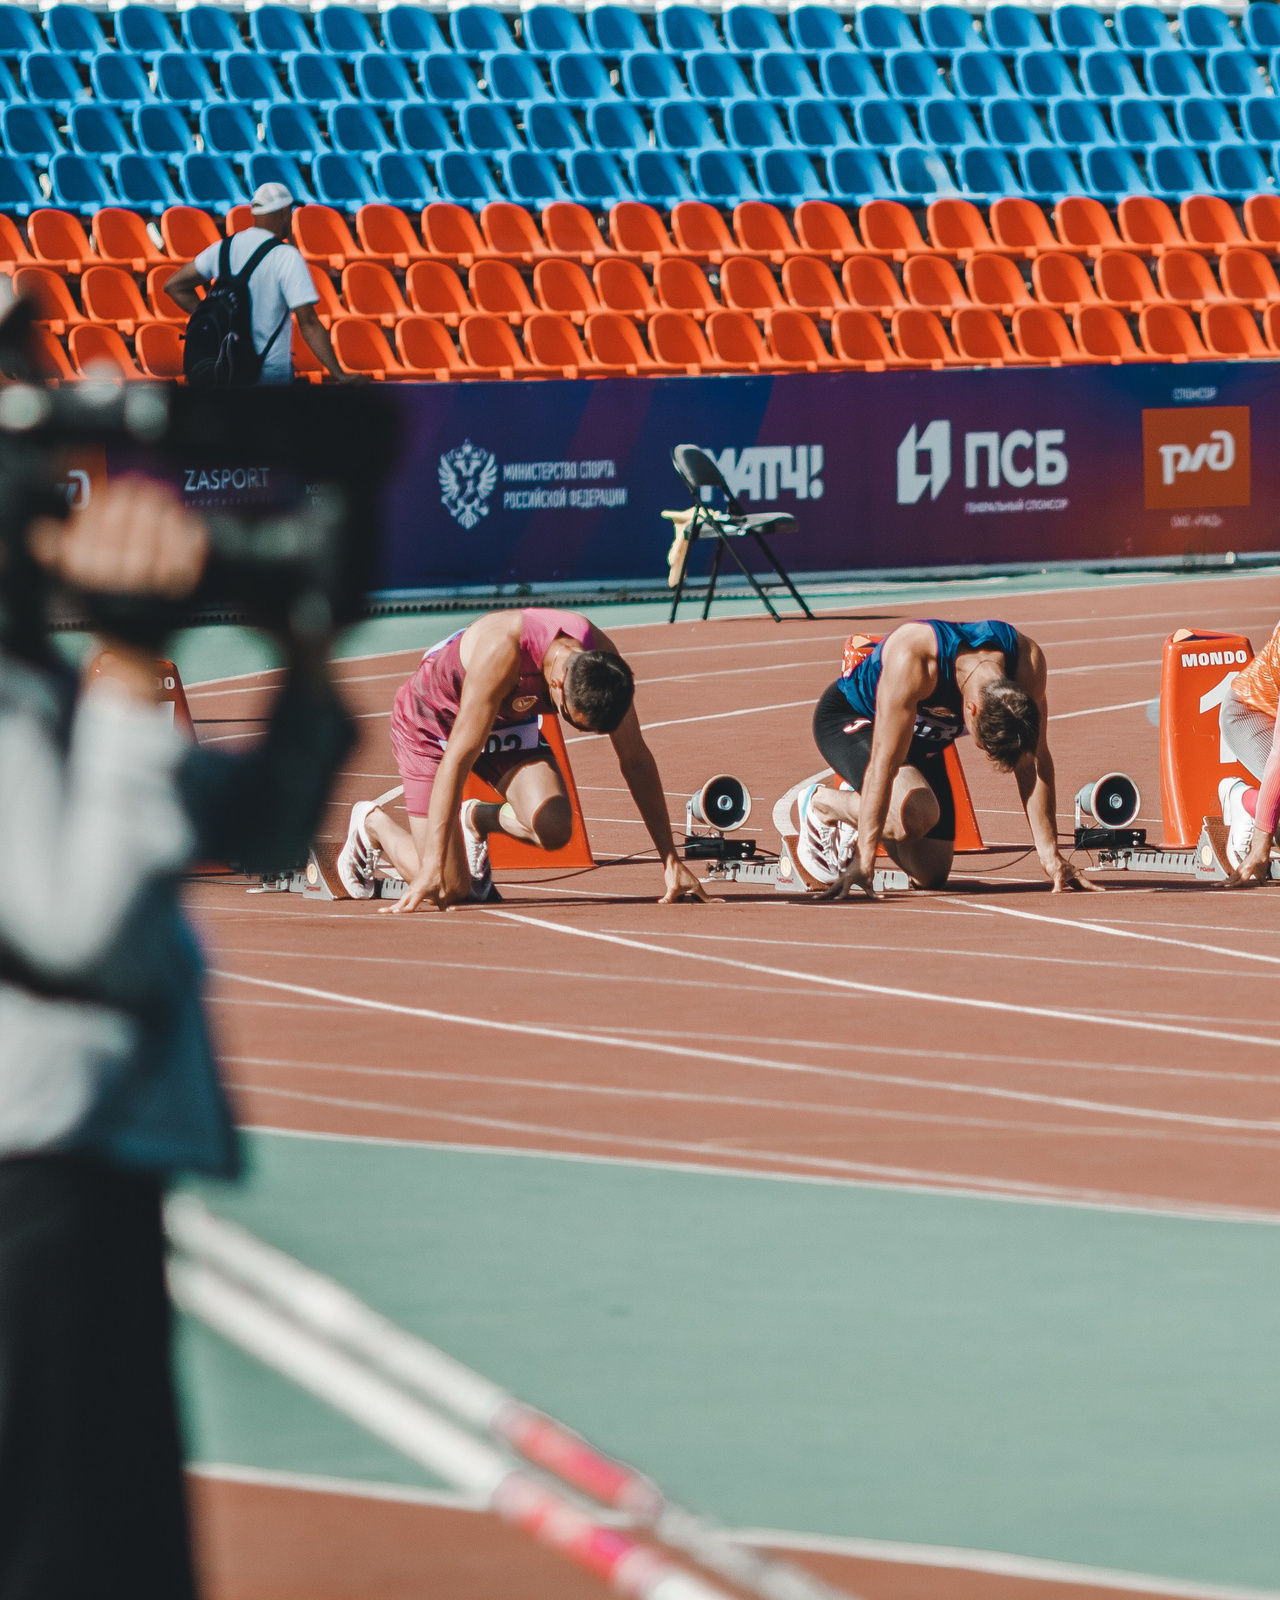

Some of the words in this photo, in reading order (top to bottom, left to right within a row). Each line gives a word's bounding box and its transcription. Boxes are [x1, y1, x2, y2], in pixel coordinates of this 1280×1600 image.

[965, 429, 1068, 489] ПСБ
[503, 461, 577, 481] МИНИСТЕРСТВО
[580, 460, 616, 479] СПОРТА
[503, 487, 567, 509] РОССИЙСКОЙ
[569, 488, 627, 509] ФЕДЕРАЦИИ
[1181, 650, 1247, 668] MONDO
